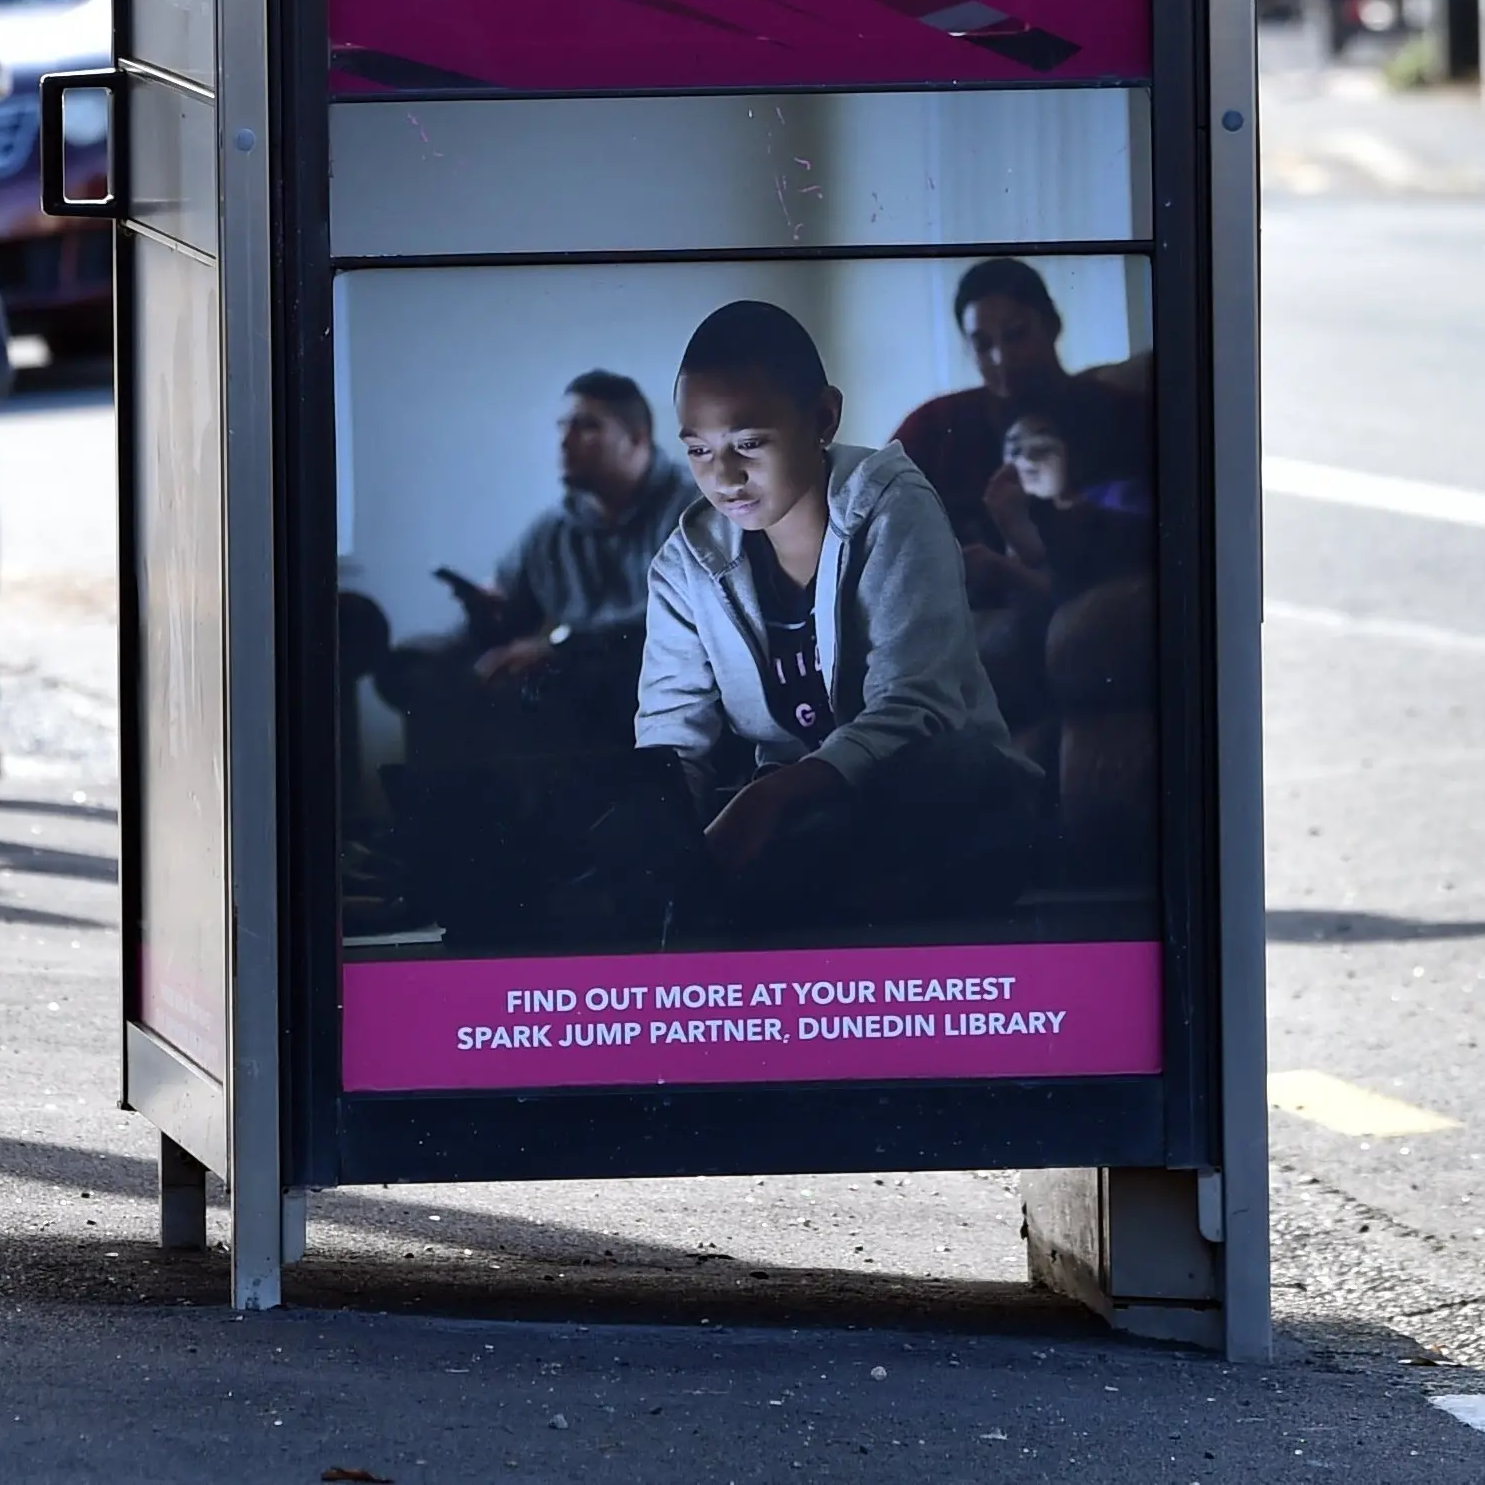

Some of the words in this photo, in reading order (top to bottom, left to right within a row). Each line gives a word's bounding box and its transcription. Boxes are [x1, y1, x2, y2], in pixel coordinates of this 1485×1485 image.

[506, 989, 577, 1013] FIND
[585, 987, 648, 1011] OUT
[655, 984, 743, 1009] MORE
[750, 982, 787, 1006] AT
[792, 980, 876, 1005] YOUR
[884, 977, 1016, 1003] NEAREST
[457, 1024, 552, 1050] SPARK
[558, 1022, 642, 1047] JUMP
[798, 1014, 935, 1040] DUNEDIN
[944, 1010, 1067, 1037] LIBRARY
